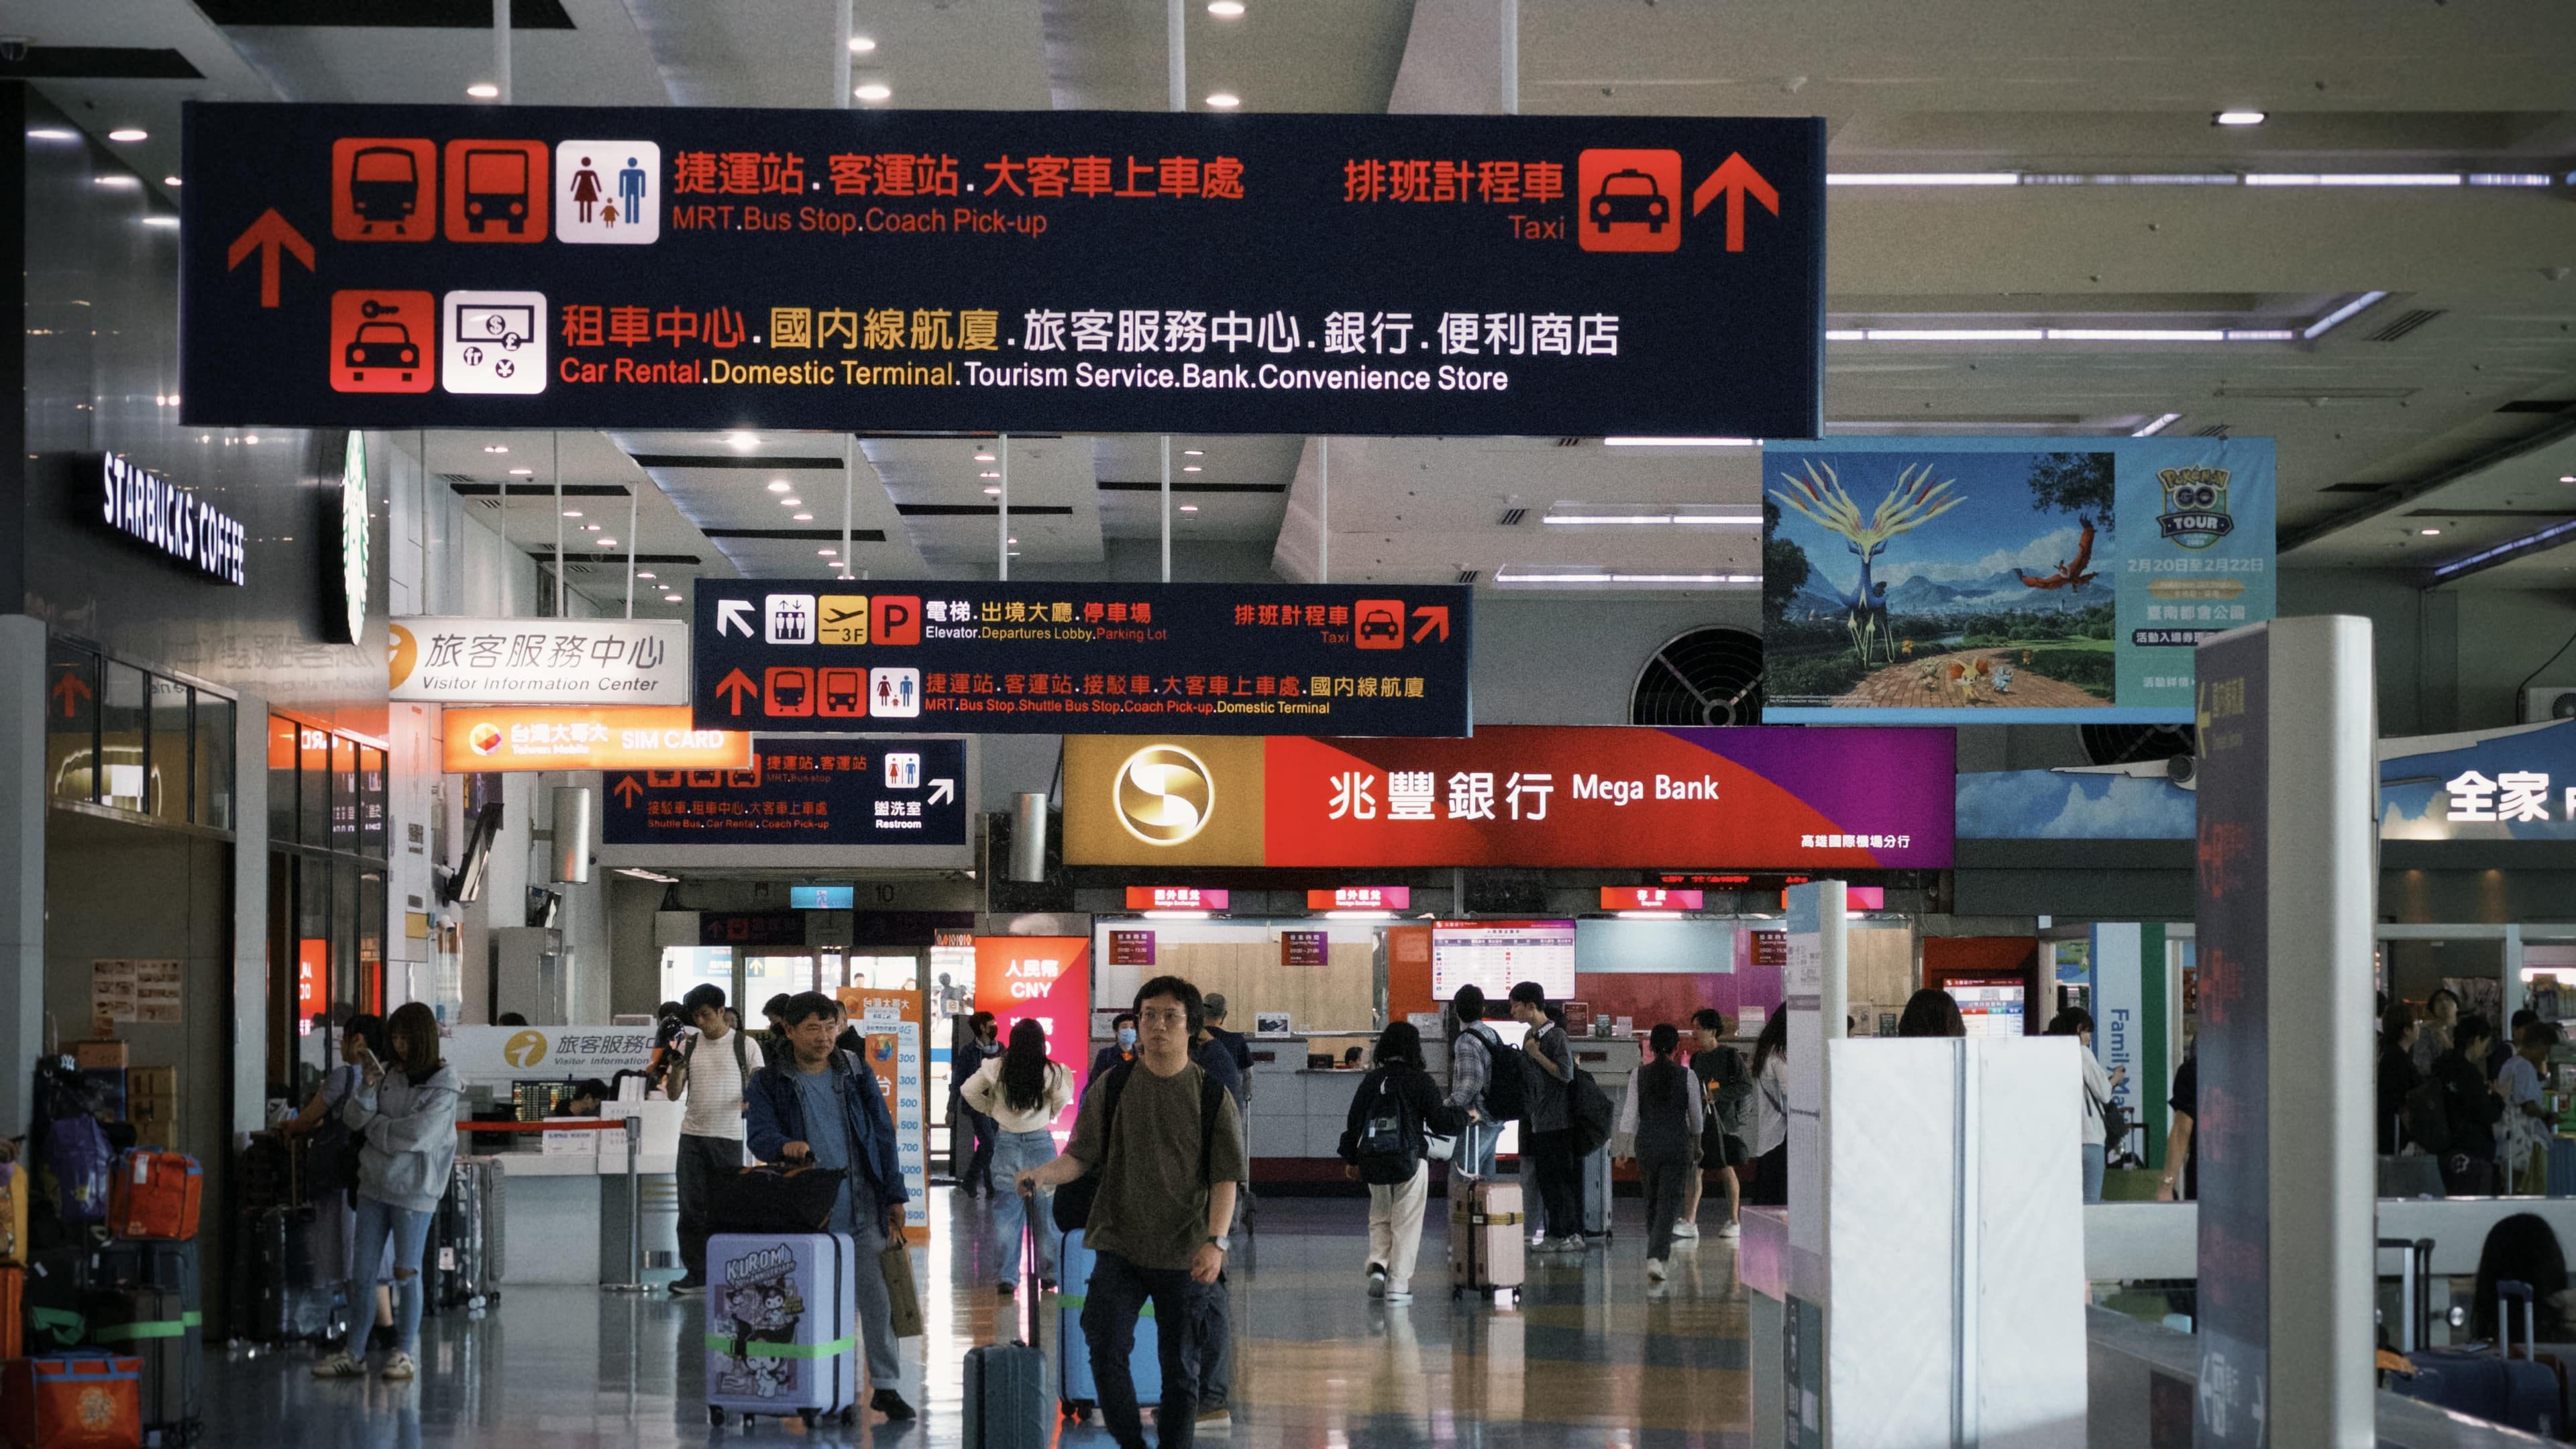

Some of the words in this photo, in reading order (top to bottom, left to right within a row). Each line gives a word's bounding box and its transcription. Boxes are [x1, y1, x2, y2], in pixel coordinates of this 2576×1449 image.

[1344, 160, 1564, 203] 排班計程車
[674, 206, 791, 231] MRT.Bus
[800, 207, 945, 235] Stop.Coach
[954, 208, 1046, 238] Pick-up
[1508, 215, 1564, 239] Taxi
[560, 358, 608, 382] Car
[616, 358, 834, 384] Rental.Domestic
[1076, 362, 1430, 390] Service.Bank.Convenience
[1438, 365, 1508, 390] Store
[2176, 486, 2217, 508] GO
[104, 450, 194, 561] STARBUCKS
[200, 501, 244, 586] COFFEE
[2174, 516, 2218, 530] TOUR
[2127, 559, 2265, 572] 2月20日至2月22日
[884, 604, 909, 638] P
[1234, 605, 1348, 626] 排班計程車
[842, 629, 864, 643] 3F
[926, 626, 1051, 640] Elevator.Departures
[1055, 627, 1144, 641] Lobby.Parking
[1148, 628, 1167, 640] Lot
[1321, 632, 1348, 643] Taxi
[425, 635, 664, 669] 旅客服務中心
[423, 676, 476, 689] Visitor
[484, 678, 589, 690] Information
[598, 677, 658, 692] Center
[925, 700, 983, 711] MRT.Bus
[987, 700, 1062, 713] Stop.Shuttle
[1066, 701, 1089, 712] Bus
[1092, 701, 1163, 714] Stop.Coach
[1167, 701, 1274, 714] Pick-up.Domestic
[1278, 702, 1330, 714] Terminal
[509, 721, 610, 744] 台灣大哥大
[622, 731, 658, 749] SIM
[663, 730, 724, 749] CARD
[1328, 771, 1554, 820] 兆豐銀行
[1573, 774, 1644, 806] Mega
[1655, 775, 1719, 799] Bank
[2446, 770, 2549, 822] 全家
[648, 820, 680, 828] Shuttle
[762, 820, 792, 828] Coach
[794, 820, 829, 829] Pick-up
[875, 820, 921, 828] Restroom
[1801, 834, 1910, 848] 高雄國際機場分行
[875, 885, 894, 902] 10
[1005, 959, 1059, 978] 人民幣
[1010, 981, 1052, 998] CNY
[555, 1057, 586, 1065] Visitor
[590, 1057, 649, 1065] Information
[898, 1054, 916, 1062] 300
[2106, 1009, 2130, 1127] FamilyMa
[899, 1076, 916, 1085] 300
[900, 1099, 917, 1107] 500
[901, 1121, 918, 1130] 500
[902, 1143, 918, 1152] 700
[901, 1165, 921, 1174] 1000
[727, 1244, 785, 1281] KUROMI
